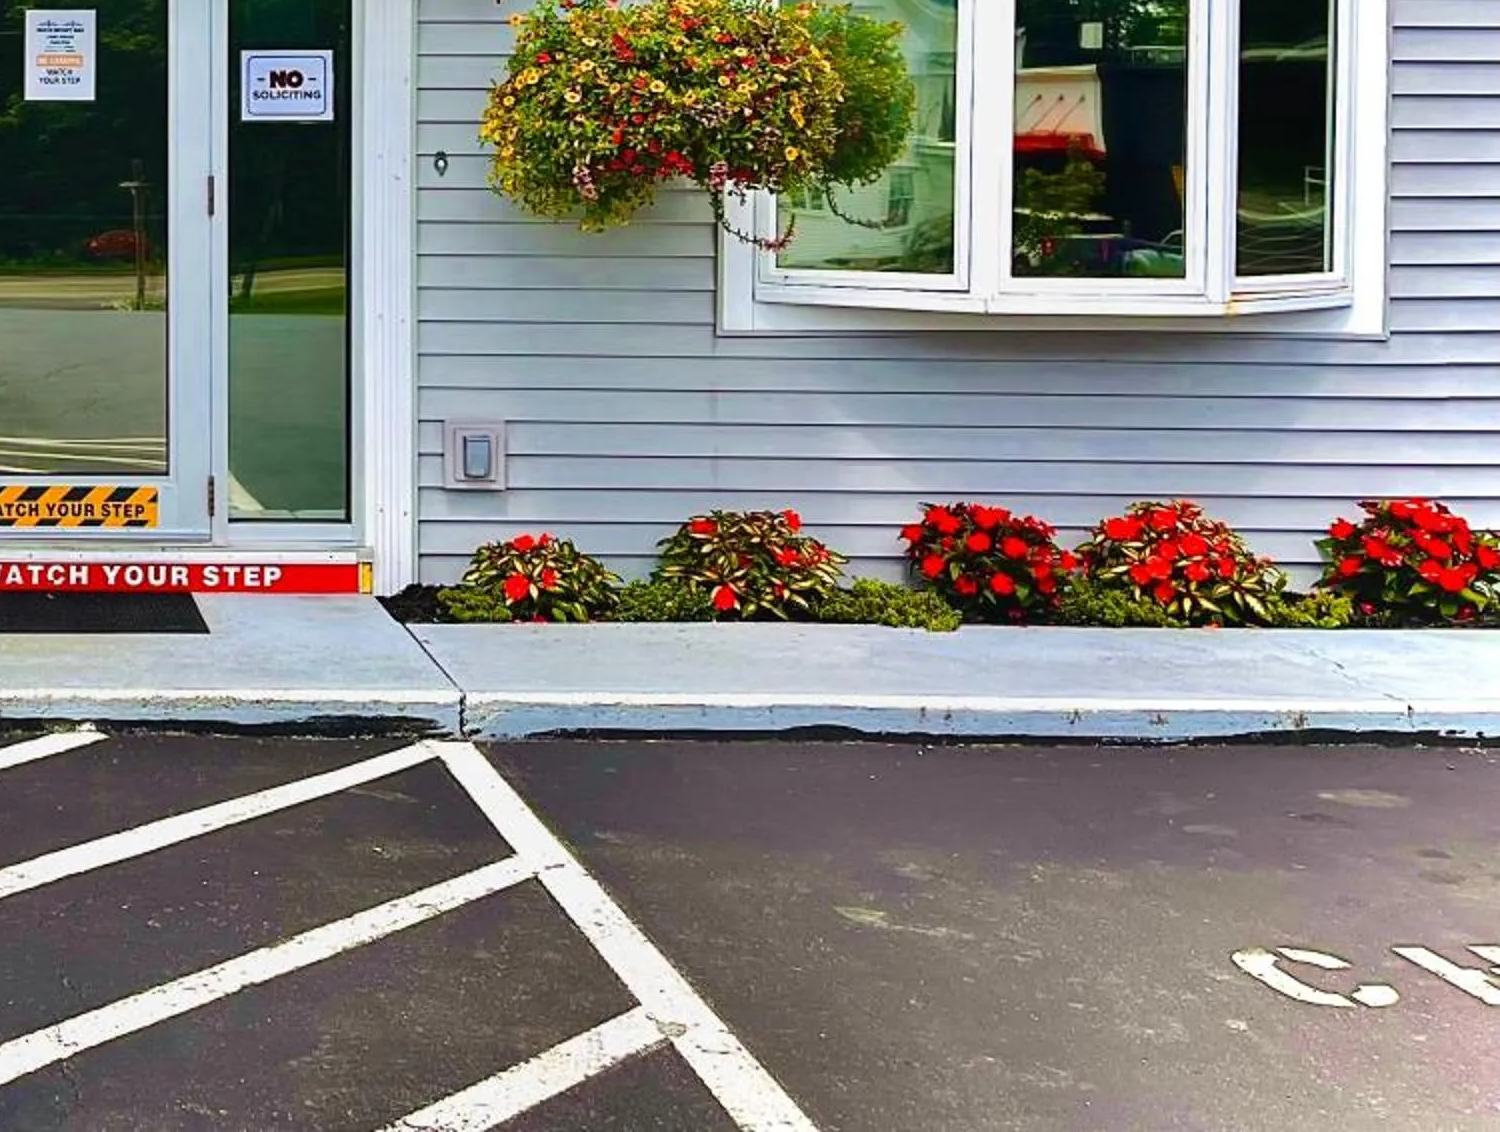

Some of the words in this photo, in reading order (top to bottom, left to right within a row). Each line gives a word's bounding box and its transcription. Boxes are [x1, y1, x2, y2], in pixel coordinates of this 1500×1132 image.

[269, 70, 304, 89] NO
[252, 90, 321, 100] SOLICITING
[45, 503, 96, 517] YOUR
[101, 503, 146, 518] STEP
[104, 565, 190, 587] YOUR
[202, 566, 283, 587] STEP
